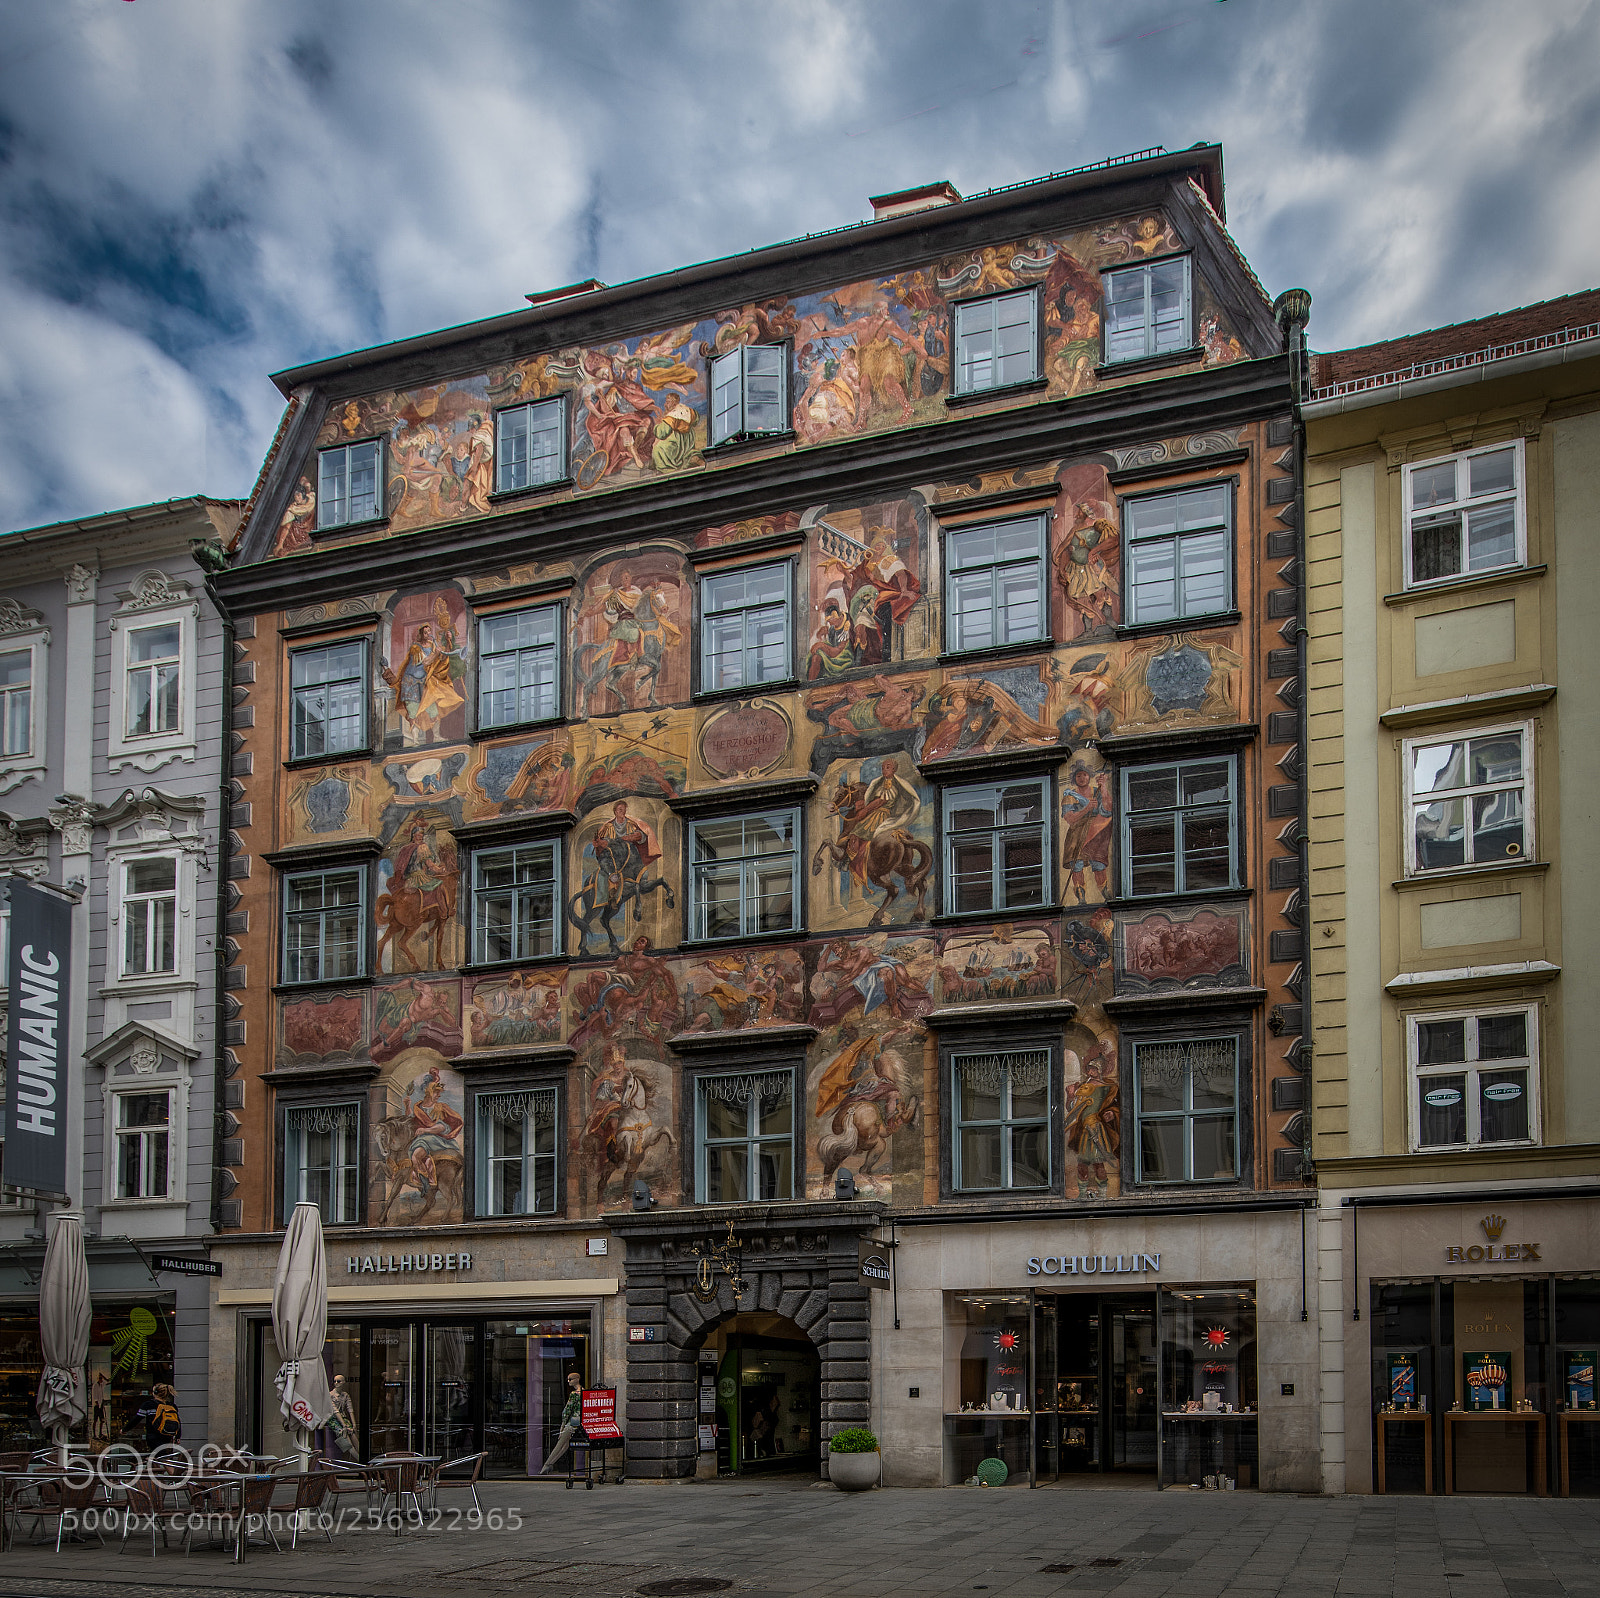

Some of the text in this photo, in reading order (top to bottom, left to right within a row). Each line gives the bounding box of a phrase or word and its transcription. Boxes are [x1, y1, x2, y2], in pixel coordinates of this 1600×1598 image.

[712, 733, 778, 751] HERZOGSHOF
[16, 944, 60, 1137] HUMANIC
[602, 1239, 606, 1249] 3
[1446, 1243, 1543, 1263] ROLEX
[161, 1259, 217, 1273] HALLHUBER
[347, 1253, 473, 1273] HALLHUBER
[1026, 1253, 1161, 1275] SCHULLIN
[862, 1266, 890, 1280] SCHULLIN
[1464, 1324, 1513, 1333] ROLEX
[293, 1401, 314, 1422] GINO
